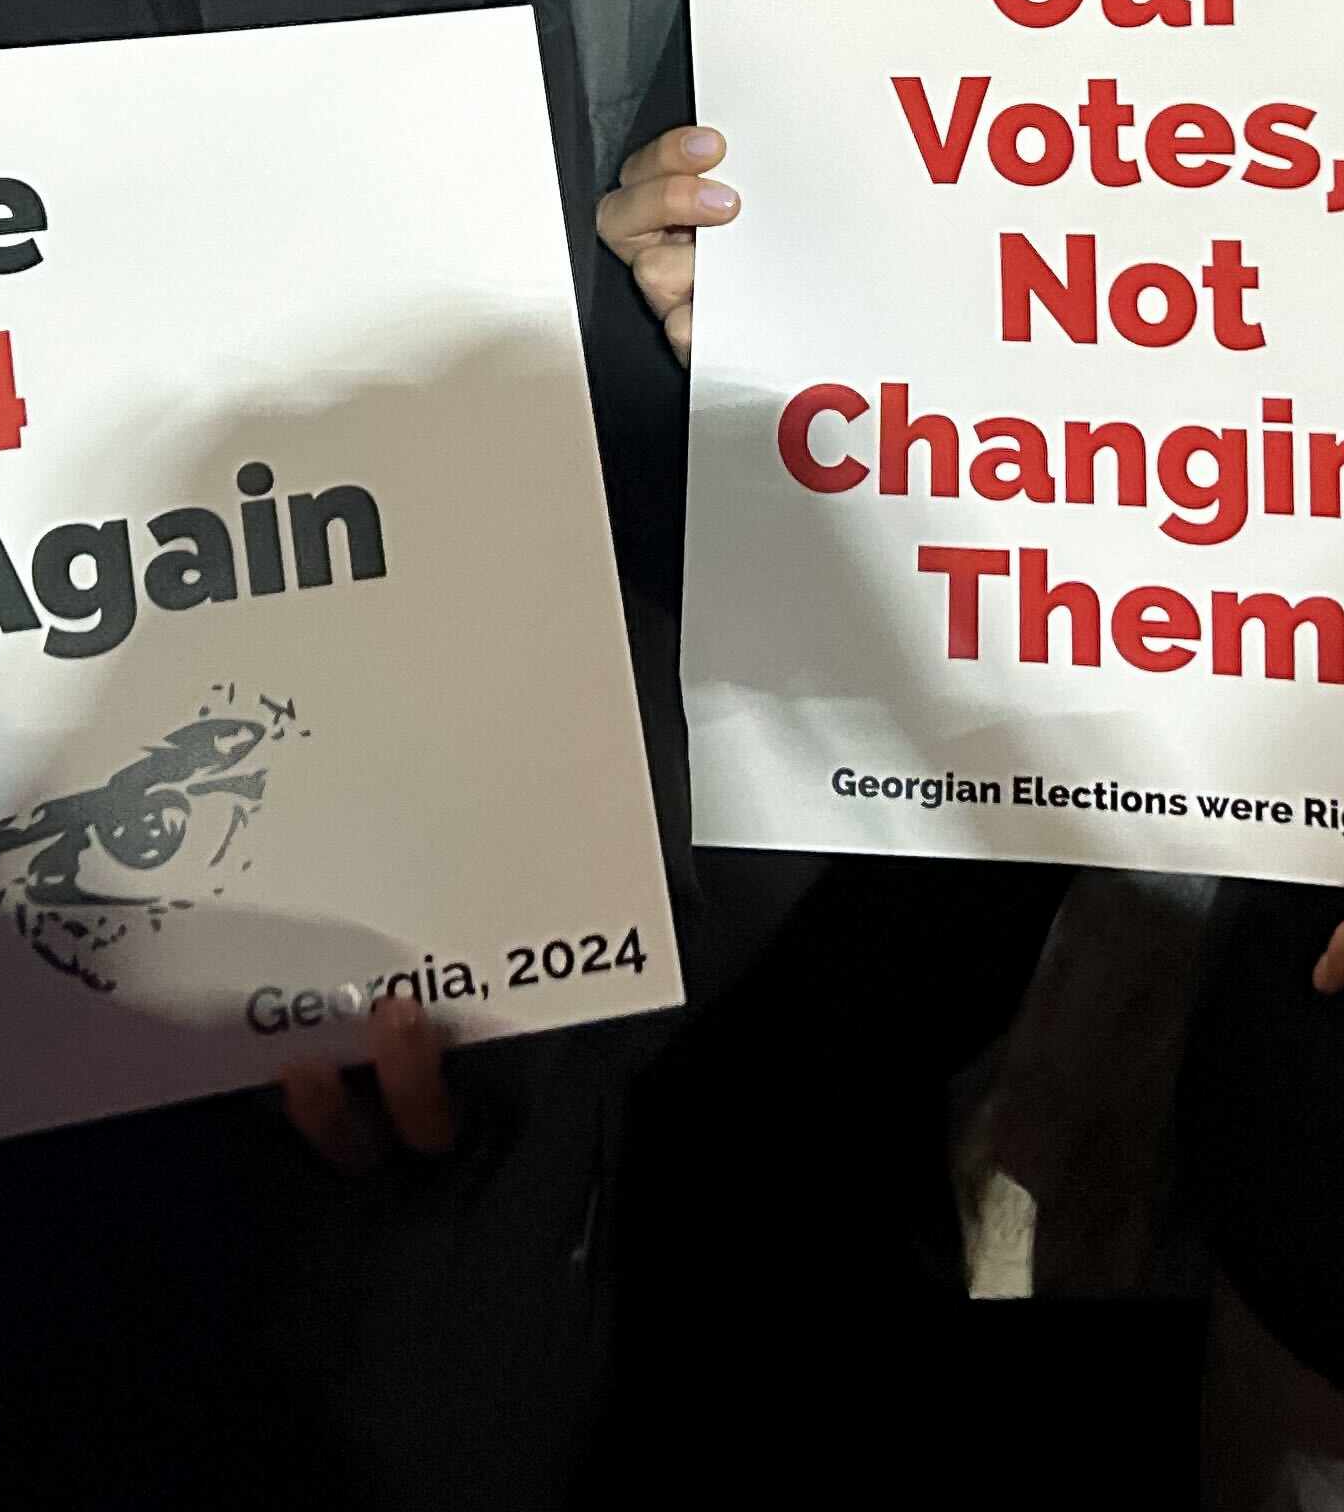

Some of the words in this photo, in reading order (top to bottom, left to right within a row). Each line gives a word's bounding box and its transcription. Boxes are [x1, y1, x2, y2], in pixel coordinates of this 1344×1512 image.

[1000, 232, 1266, 352] Not
[831, 767, 1001, 809] Georgian
[1012, 775, 1188, 816] Elections
[1196, 796, 1293, 824] were
[506, 926, 648, 989] 2024
